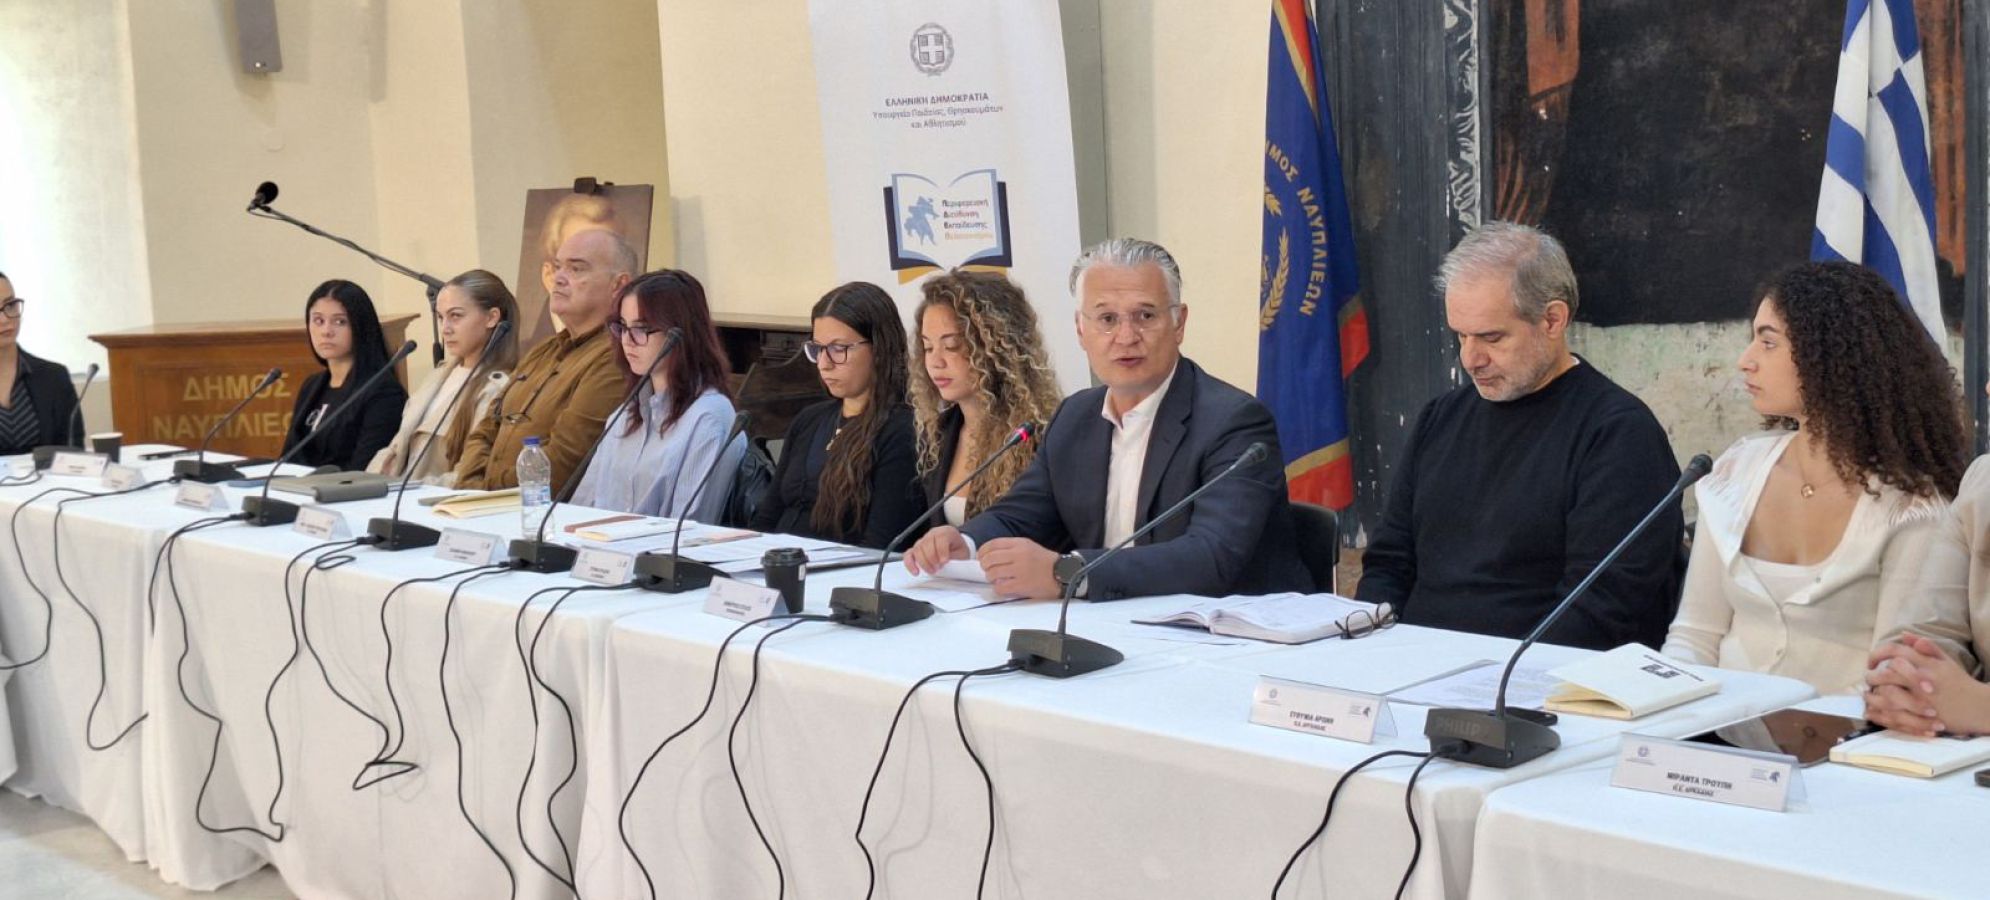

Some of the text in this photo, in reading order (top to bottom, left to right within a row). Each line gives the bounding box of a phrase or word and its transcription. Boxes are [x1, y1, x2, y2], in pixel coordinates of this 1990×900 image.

[885, 92, 990, 107] ΕΛΛΗΝΙΚΗ ΔΗΜΟΚΡΑΤΙΑ
[1296, 186, 1329, 317] ΝΑΥΠΛΙΕΩΝ
[183, 373, 292, 401] ΔΗΜΟΣ
